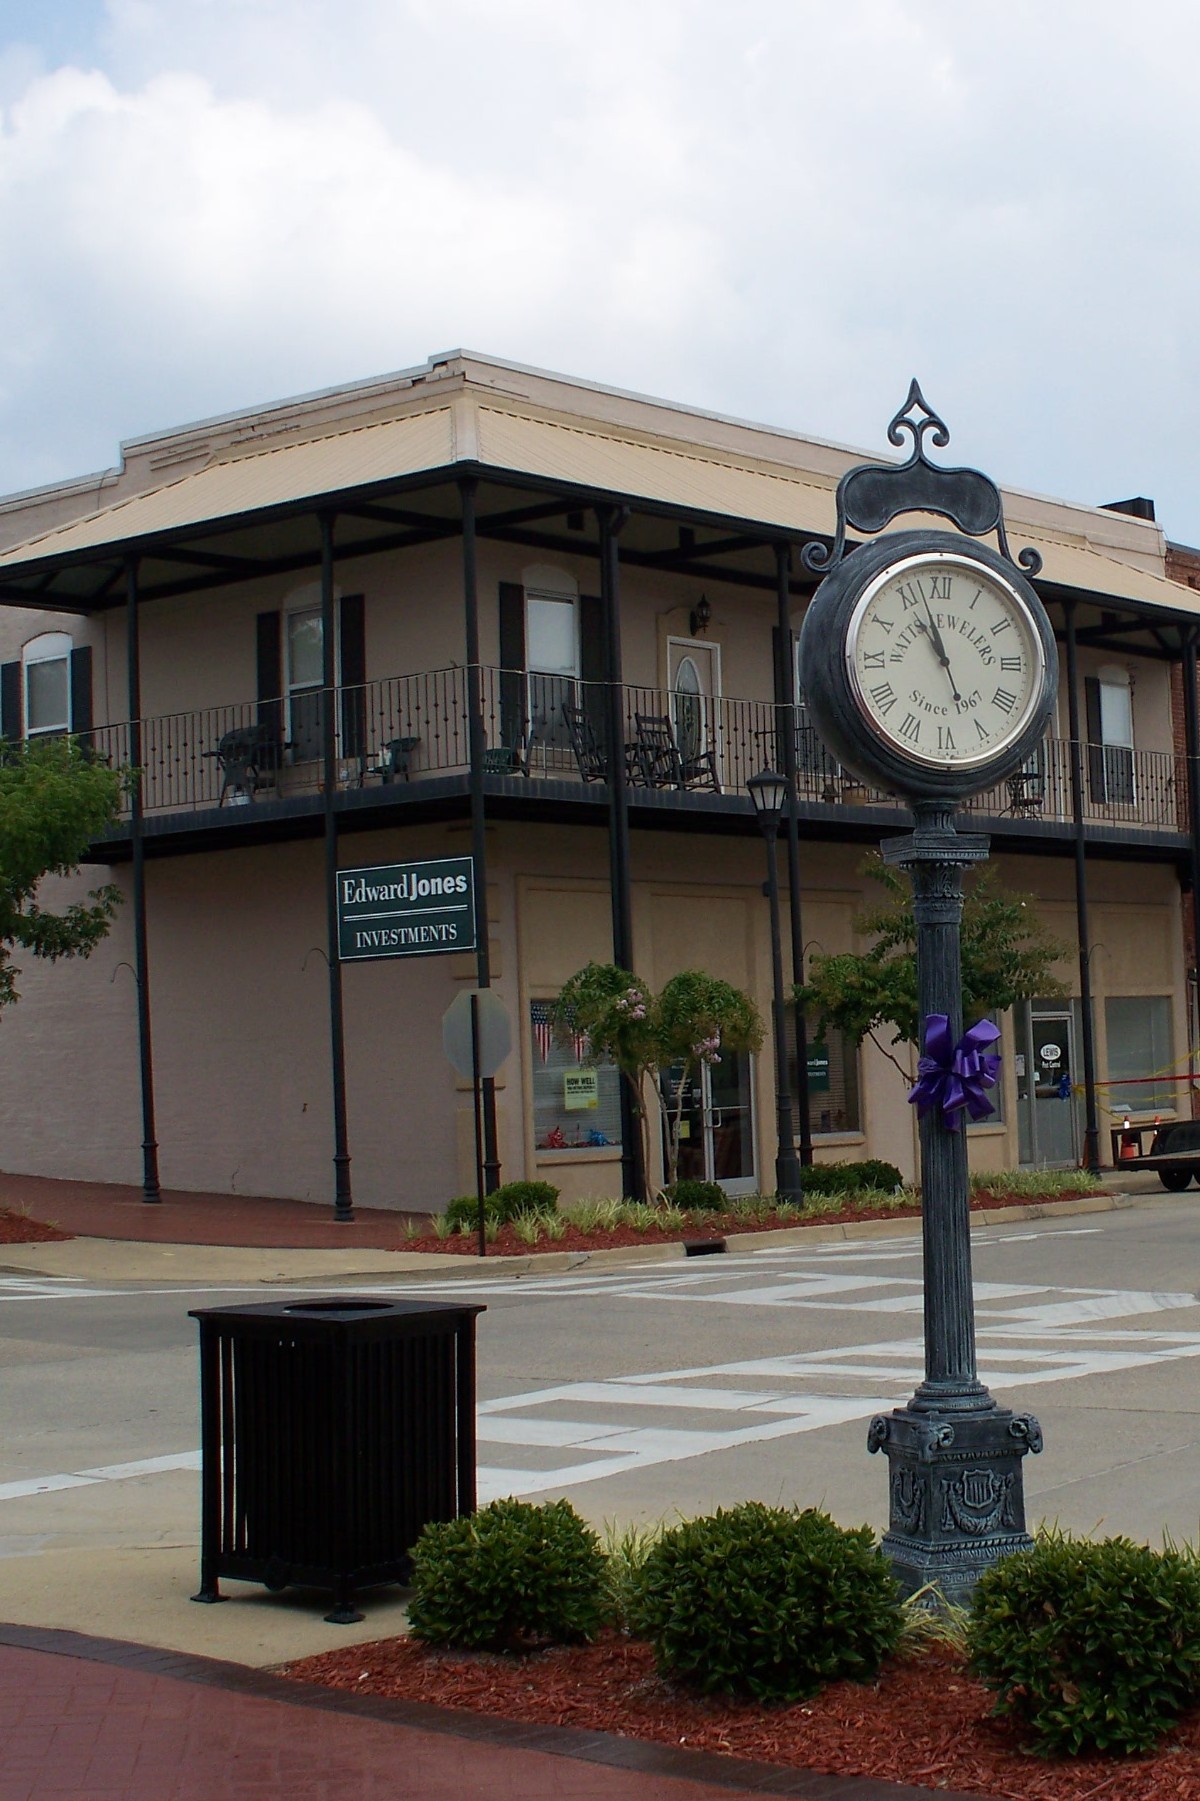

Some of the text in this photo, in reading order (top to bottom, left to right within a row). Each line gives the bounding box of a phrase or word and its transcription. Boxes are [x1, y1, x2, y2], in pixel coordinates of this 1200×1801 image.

[895, 582, 919, 611] XI
[929, 576, 953, 600] XII
[968, 589, 983, 610] I
[872, 613, 894, 635] X
[990, 616, 1012, 637] II
[890, 620, 924, 663] WATTS
[864, 650, 885, 670] IX
[1000, 655, 1022, 673] III
[870, 681, 898, 717] VIII
[909, 689, 983, 716] Since 1967
[898, 712, 922, 743] VII
[937, 726, 956, 750] VI
[973, 718, 990, 741] V
[356, 923, 458, 948] INVESTMENTS
[580, 1077, 596, 1085] WELL
